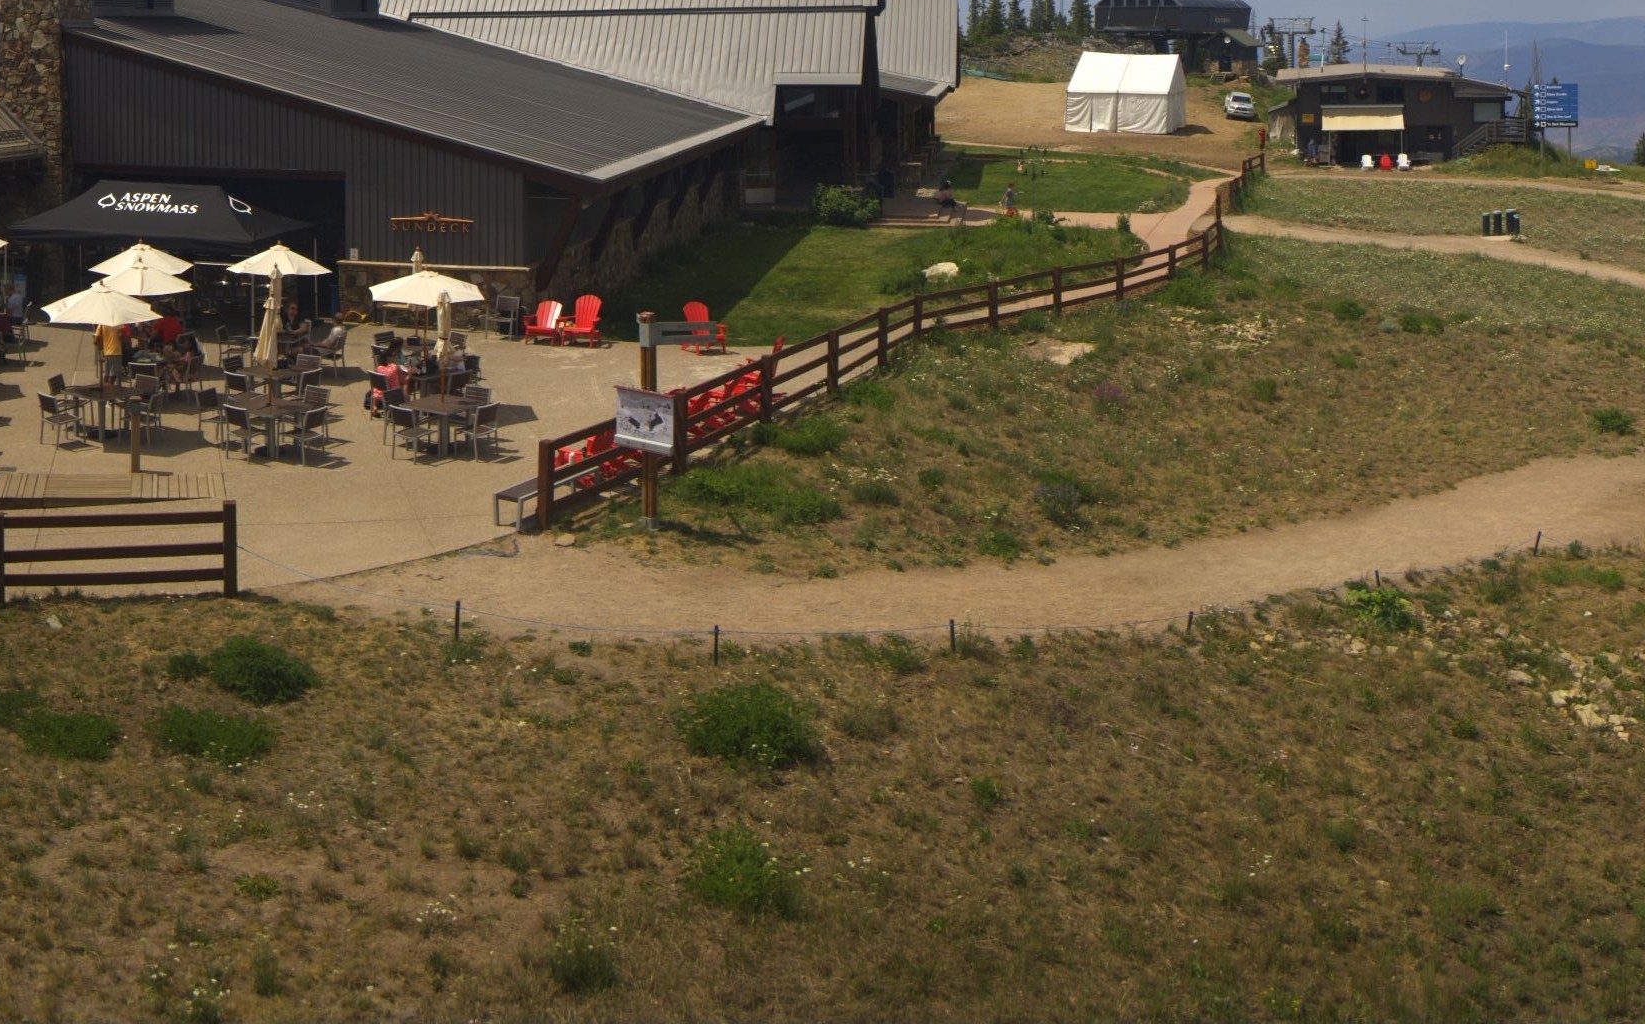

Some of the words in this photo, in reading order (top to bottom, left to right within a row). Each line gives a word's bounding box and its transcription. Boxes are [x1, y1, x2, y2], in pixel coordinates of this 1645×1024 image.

[120, 192, 171, 204] ASPEN
[114, 202, 199, 214] SNOWMASS
[391, 222, 469, 233] SUNDECK
